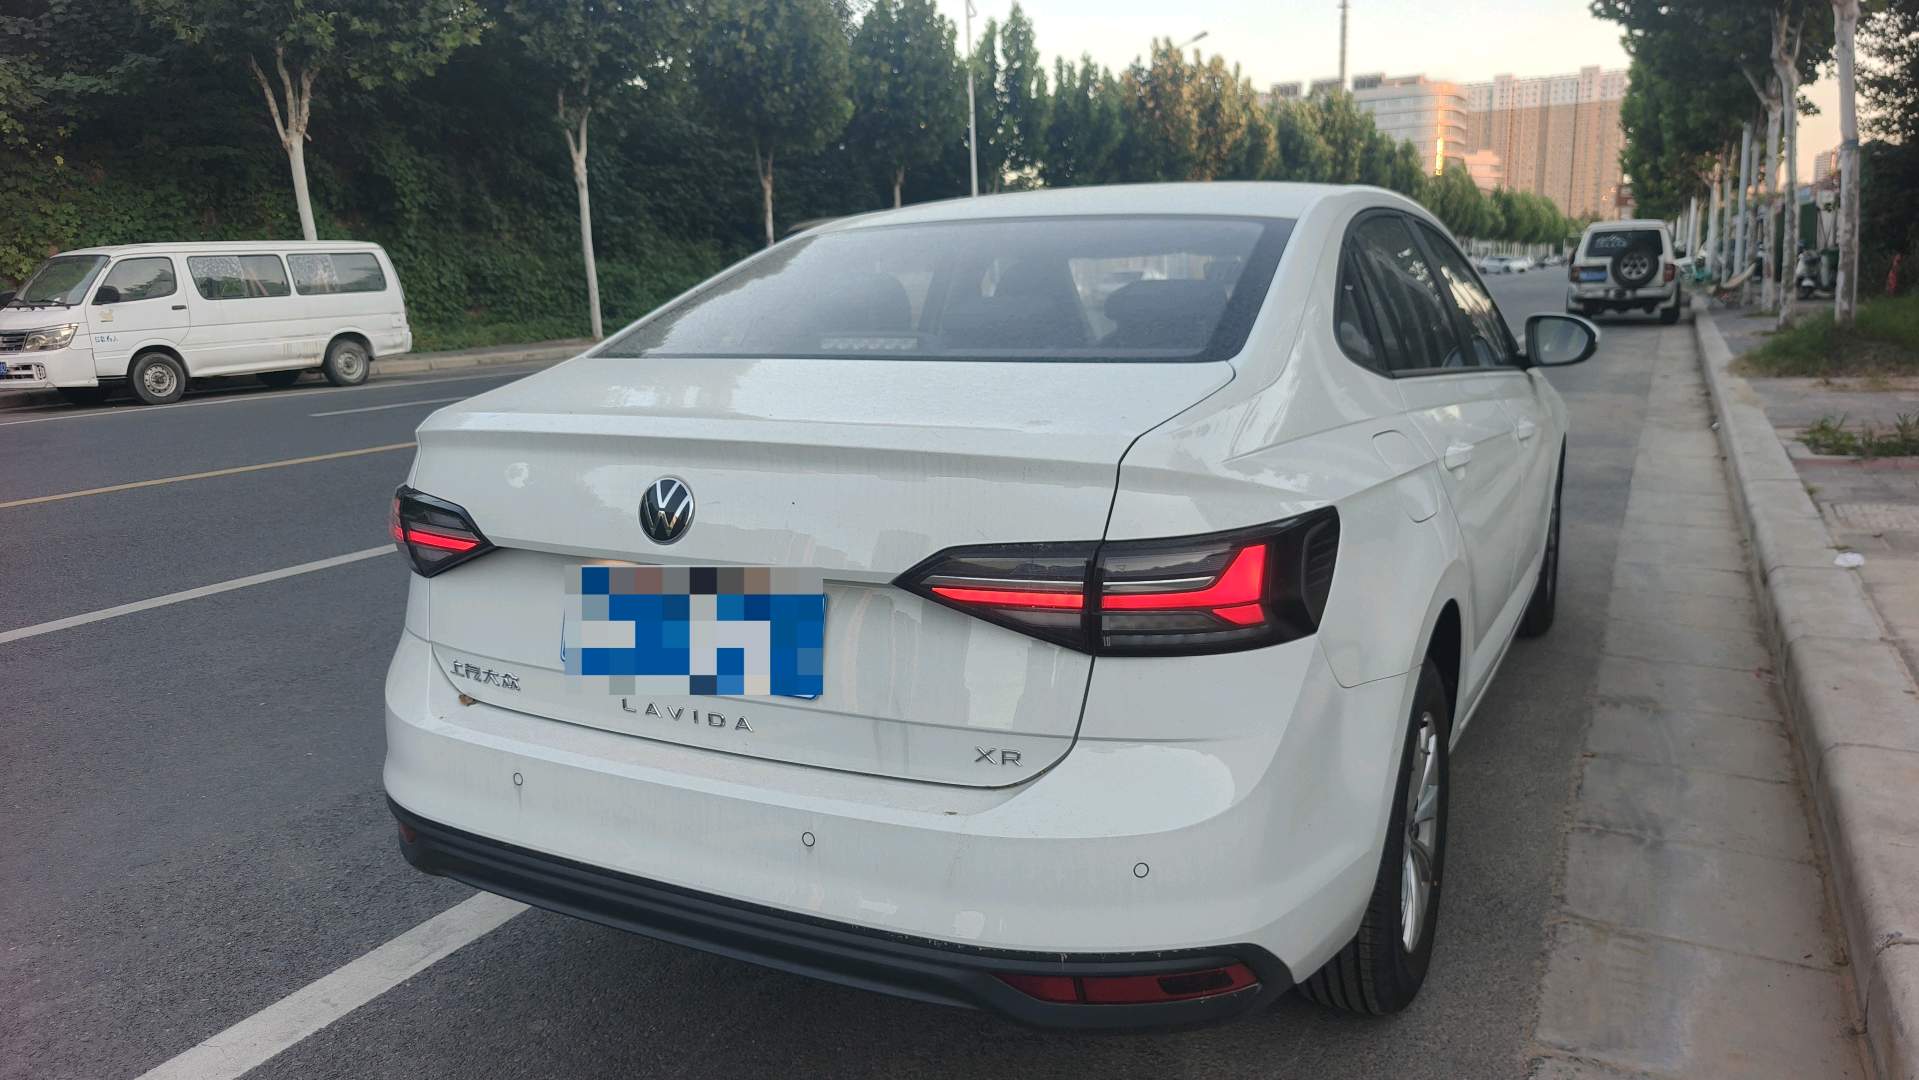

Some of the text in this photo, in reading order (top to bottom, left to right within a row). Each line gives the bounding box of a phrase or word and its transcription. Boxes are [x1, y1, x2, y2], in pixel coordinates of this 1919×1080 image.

[450, 660, 521, 691] 上汽大众
[622, 697, 753, 733] LAVIDA
[975, 745, 1023, 767] XR
